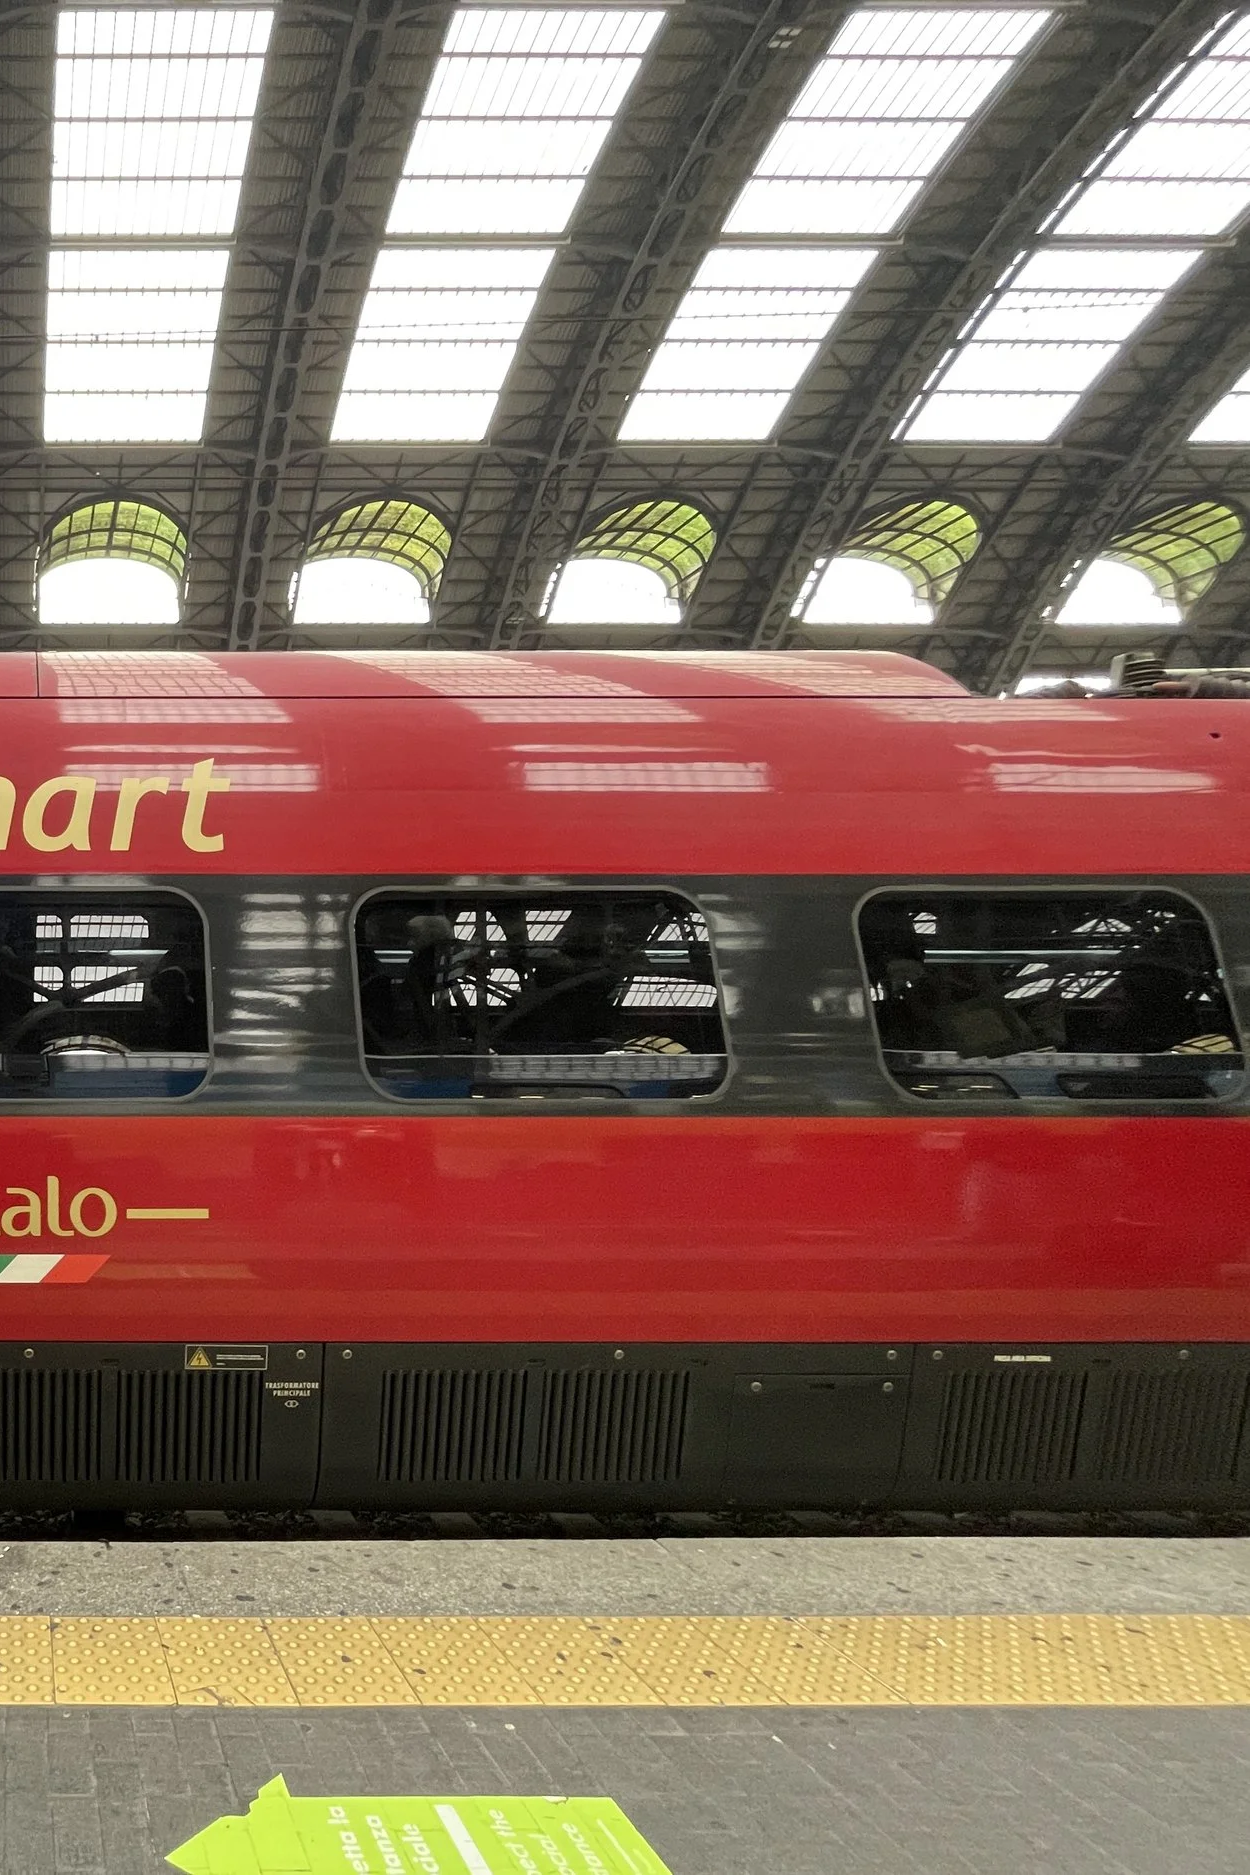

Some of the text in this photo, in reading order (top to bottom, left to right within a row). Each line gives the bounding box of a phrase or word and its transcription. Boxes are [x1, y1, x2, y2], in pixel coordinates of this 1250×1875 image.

[327, 1806, 370, 1875] etta la
[401, 1823, 440, 1875] ciale
[489, 1808, 517, 1838] the
